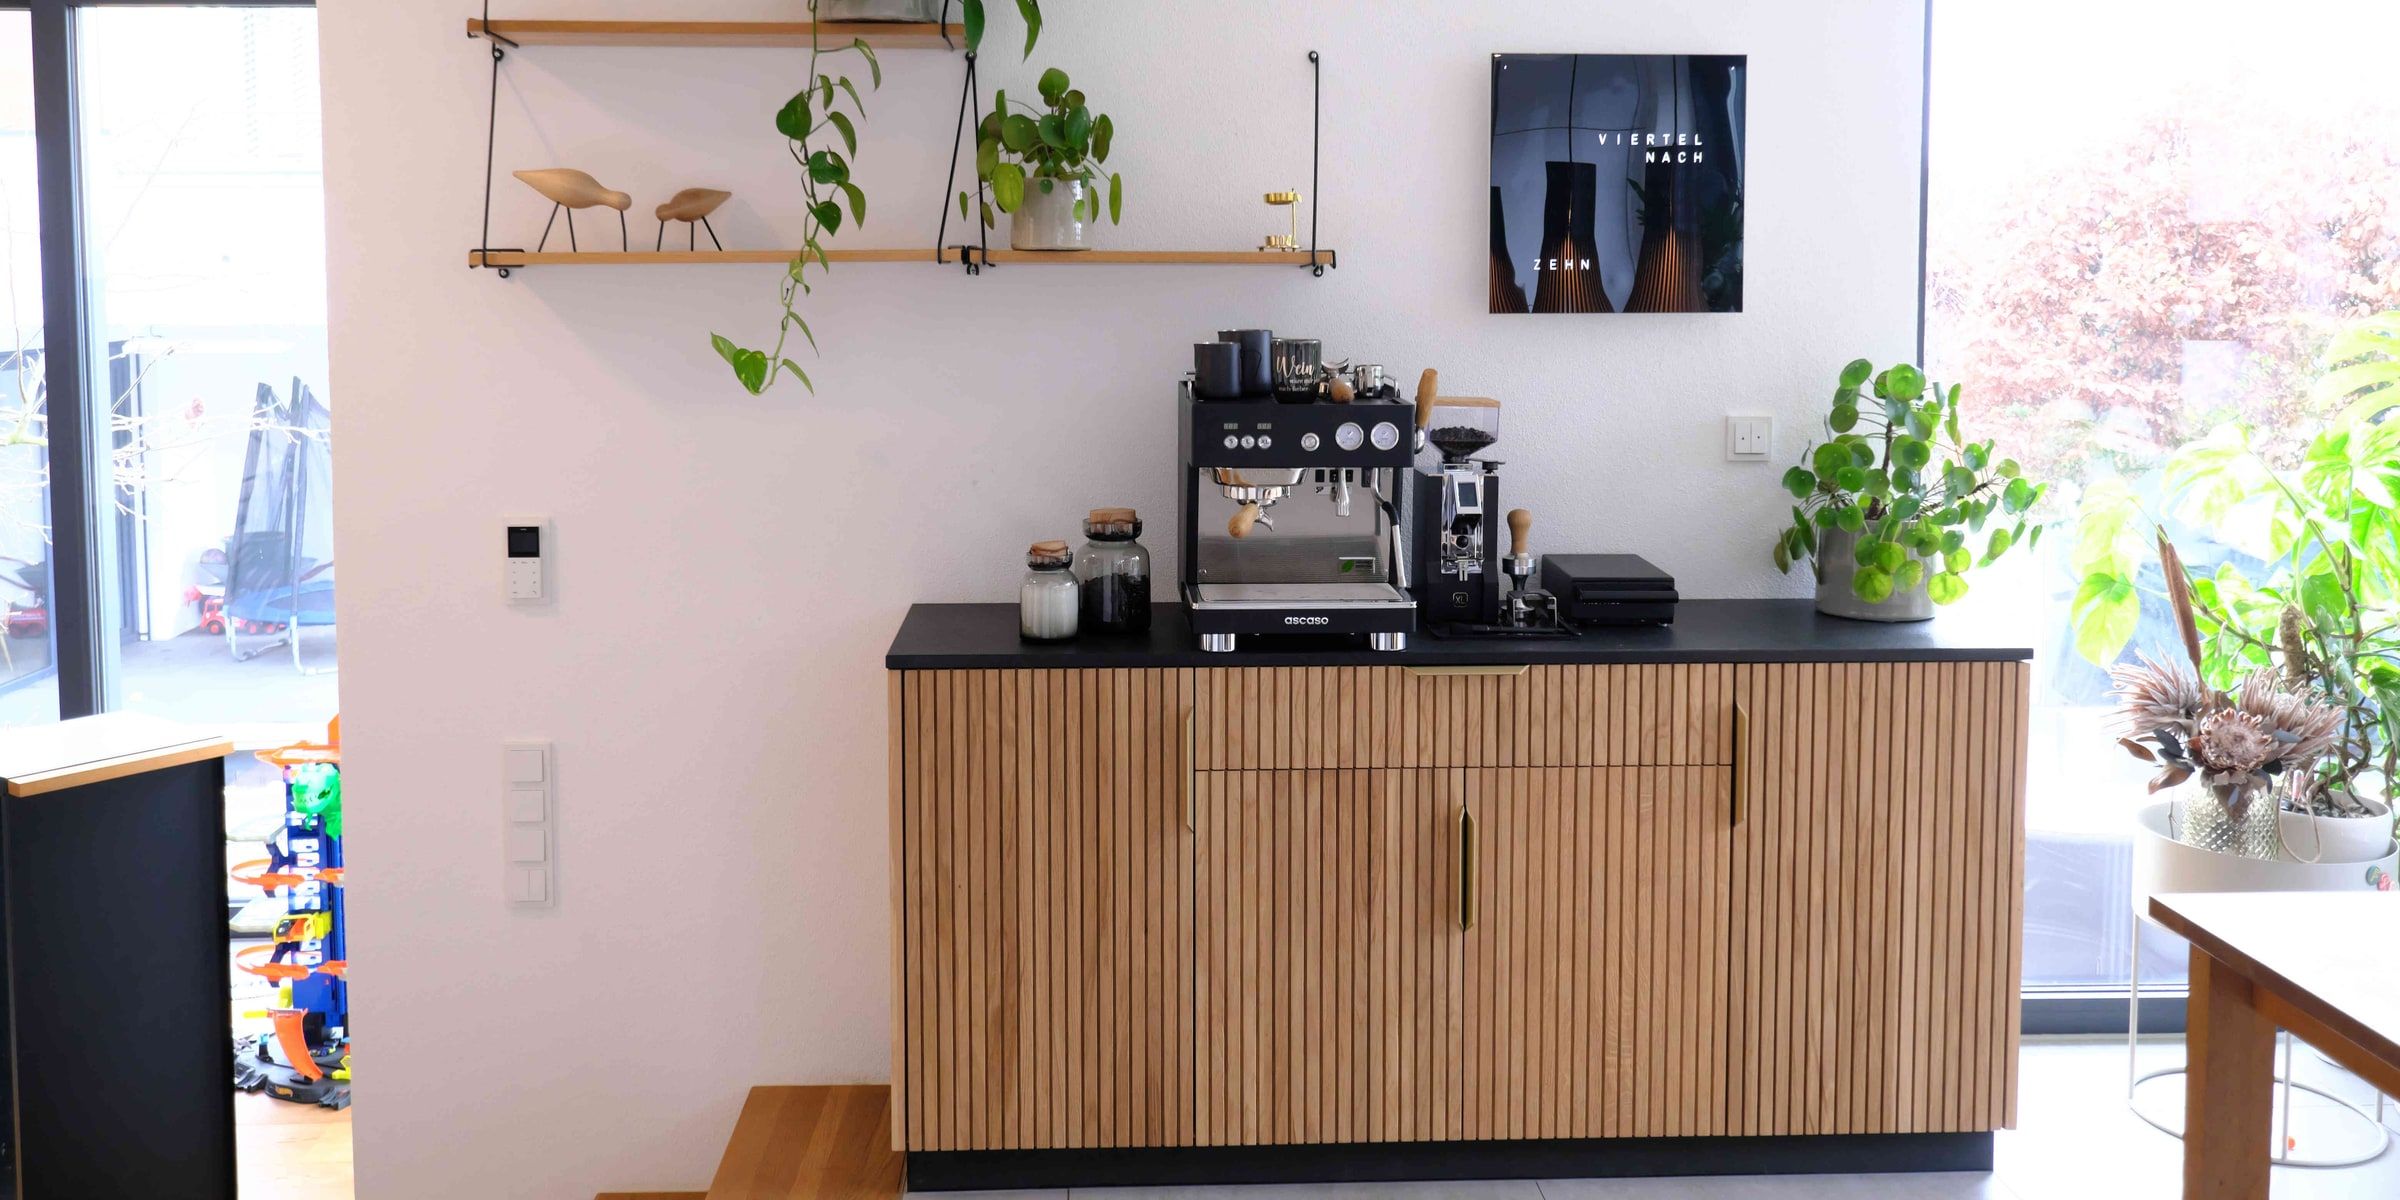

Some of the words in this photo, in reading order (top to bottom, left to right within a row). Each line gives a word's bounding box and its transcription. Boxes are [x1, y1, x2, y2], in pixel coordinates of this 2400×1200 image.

[1599, 134, 1702, 145] VIERTEL
[1646, 152, 1702, 163] NACH
[1534, 259, 1589, 270] ZEHN
[1276, 355, 1314, 378] Wein
[1284, 616, 1329, 625] ascaso
